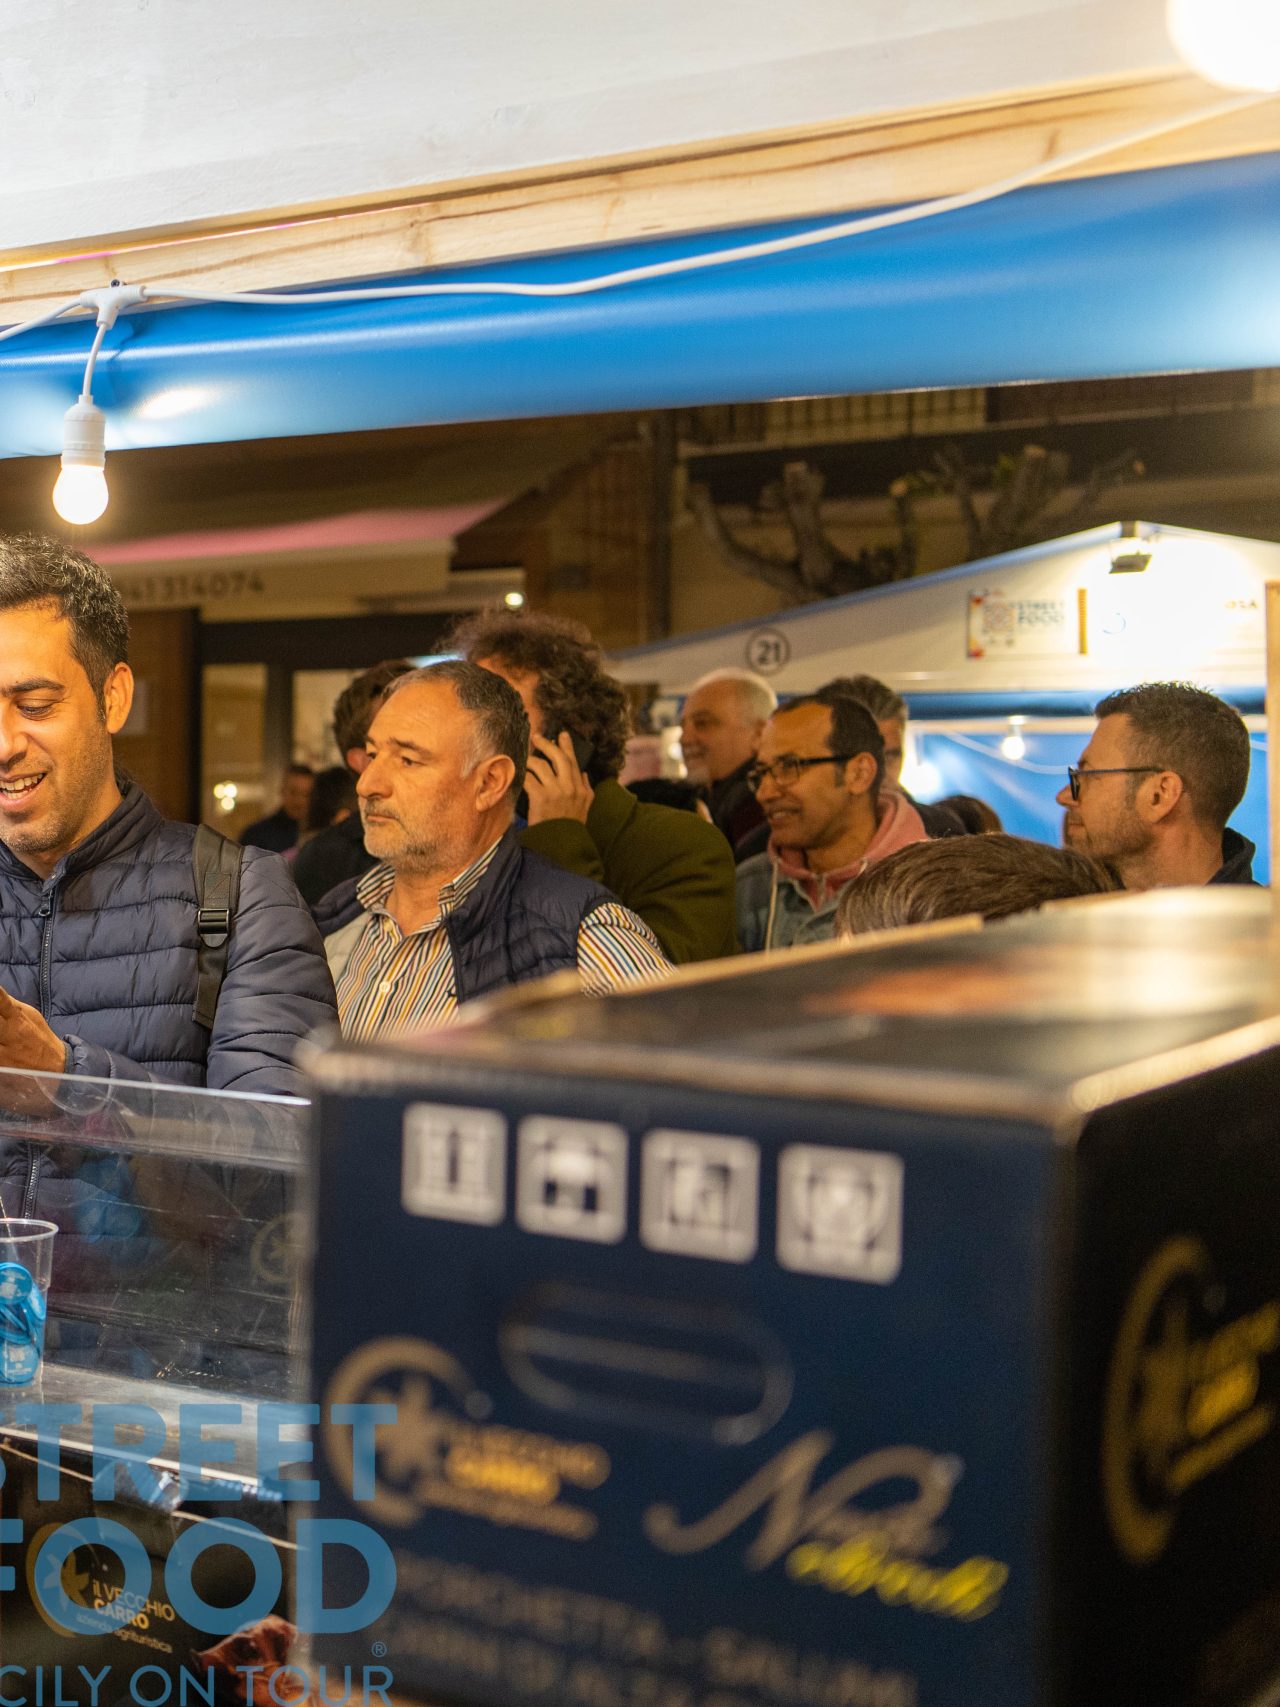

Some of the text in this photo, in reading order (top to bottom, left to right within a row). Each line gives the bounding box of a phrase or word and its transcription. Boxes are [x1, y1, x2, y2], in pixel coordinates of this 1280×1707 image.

[758, 640, 780, 664] 21
[94, 1598, 150, 1630] CARRO
[103, 1583, 176, 1621] VECCHIO
